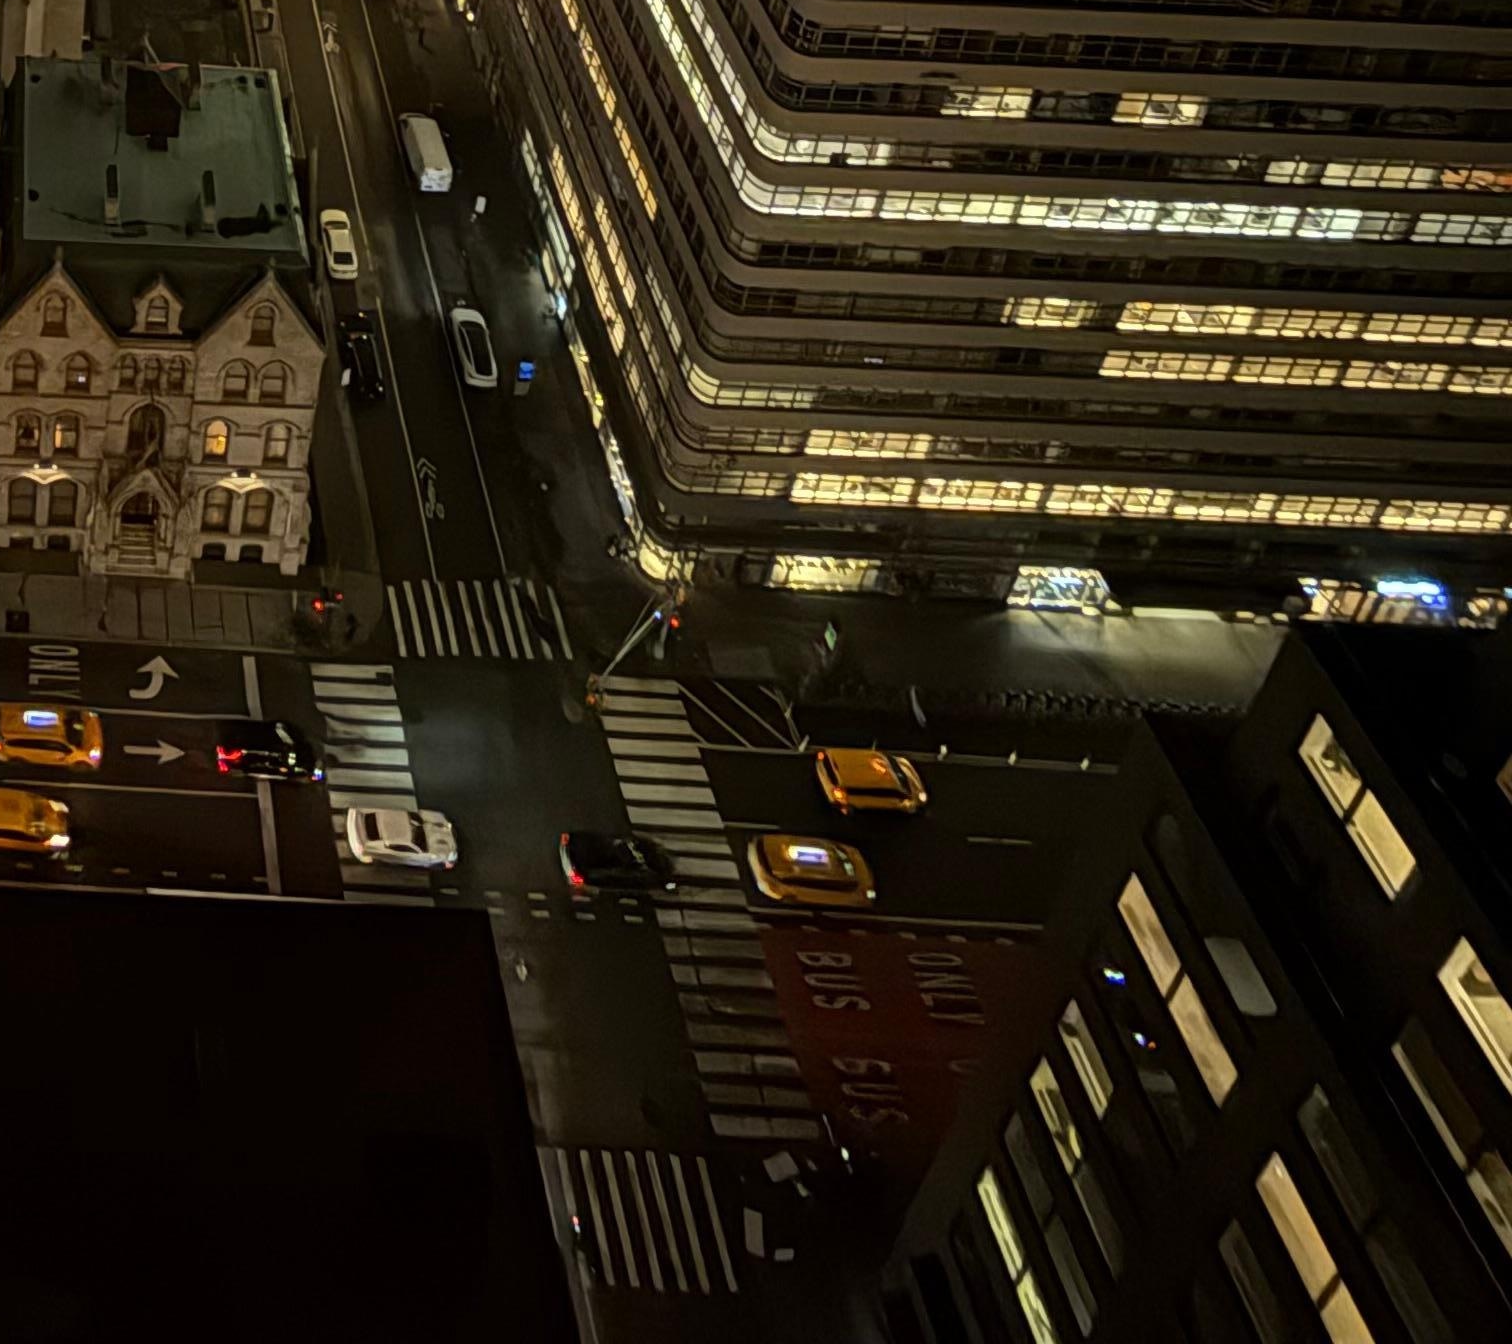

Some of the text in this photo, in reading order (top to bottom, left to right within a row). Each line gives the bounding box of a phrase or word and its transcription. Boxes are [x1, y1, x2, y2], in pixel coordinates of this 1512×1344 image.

[27, 644, 82, 701] ONLY
[795, 951, 872, 1012] BUS
[907, 952, 986, 1026] ONLY
